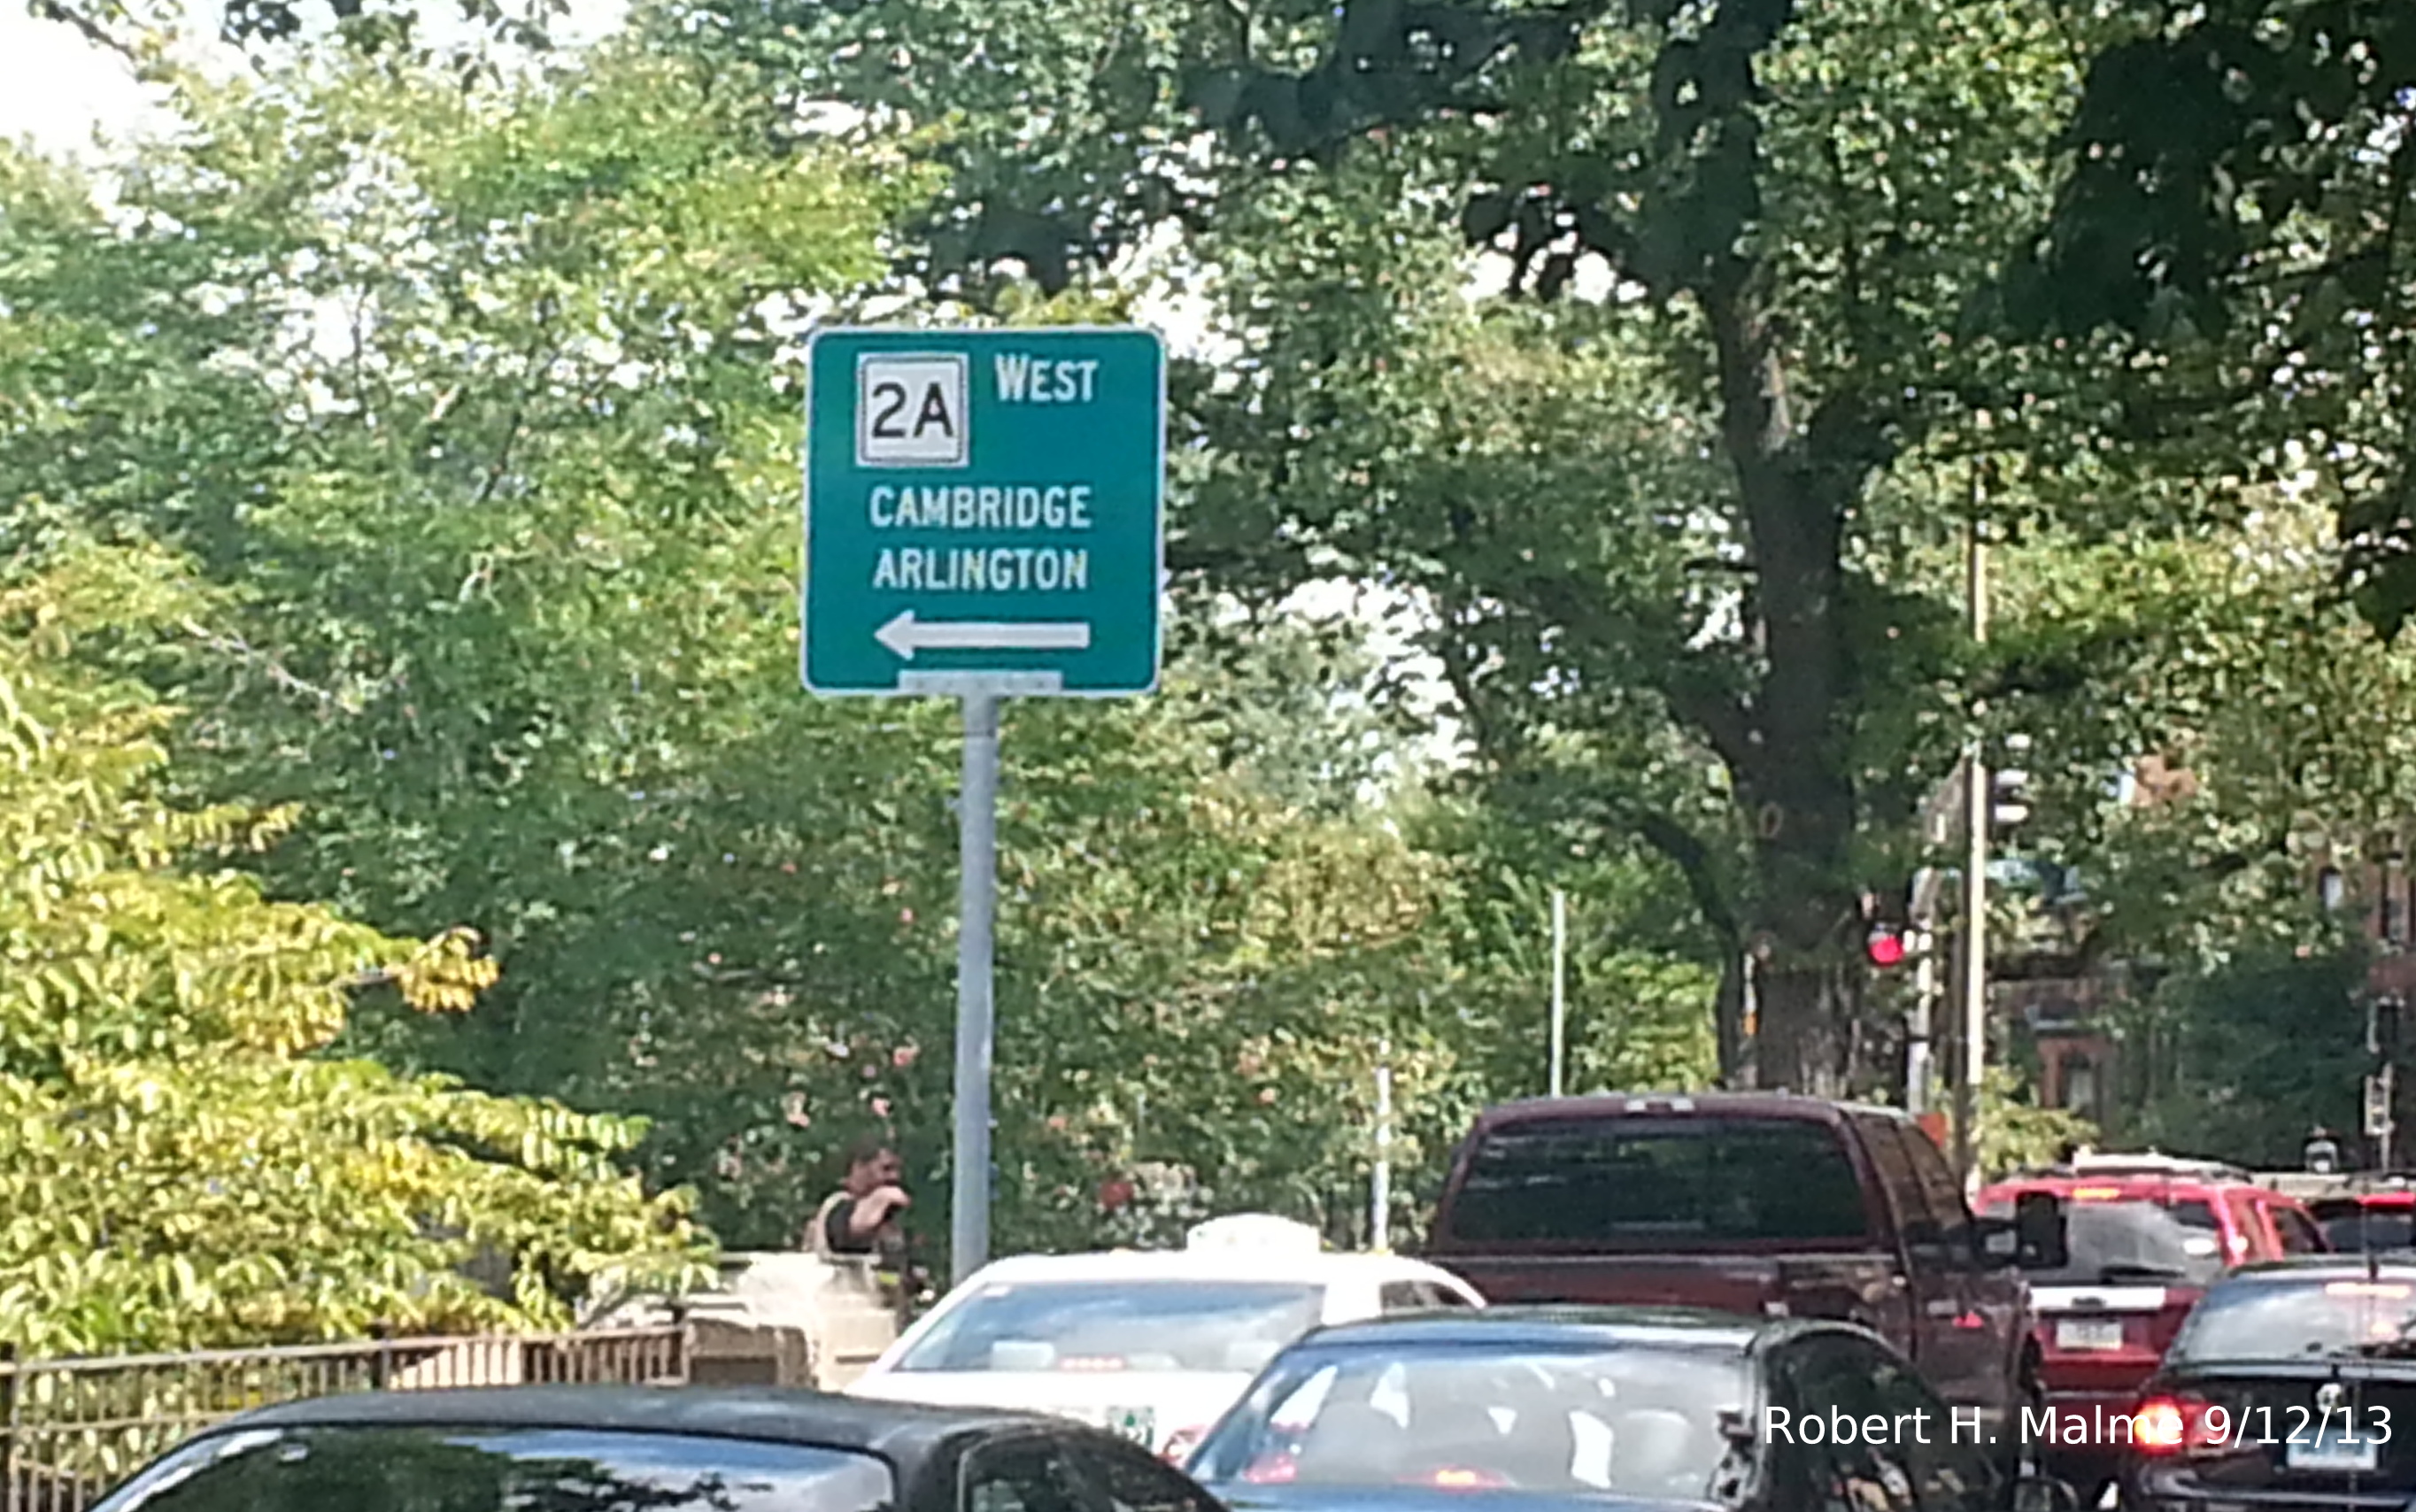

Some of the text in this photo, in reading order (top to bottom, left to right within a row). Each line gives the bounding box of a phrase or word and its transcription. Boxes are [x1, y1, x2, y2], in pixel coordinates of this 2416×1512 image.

[995, 353, 1098, 402] WEST
[872, 382, 953, 437] 2A
[869, 486, 1092, 528] CAMBRIDGE
[873, 549, 1088, 590] ARLINGTON
